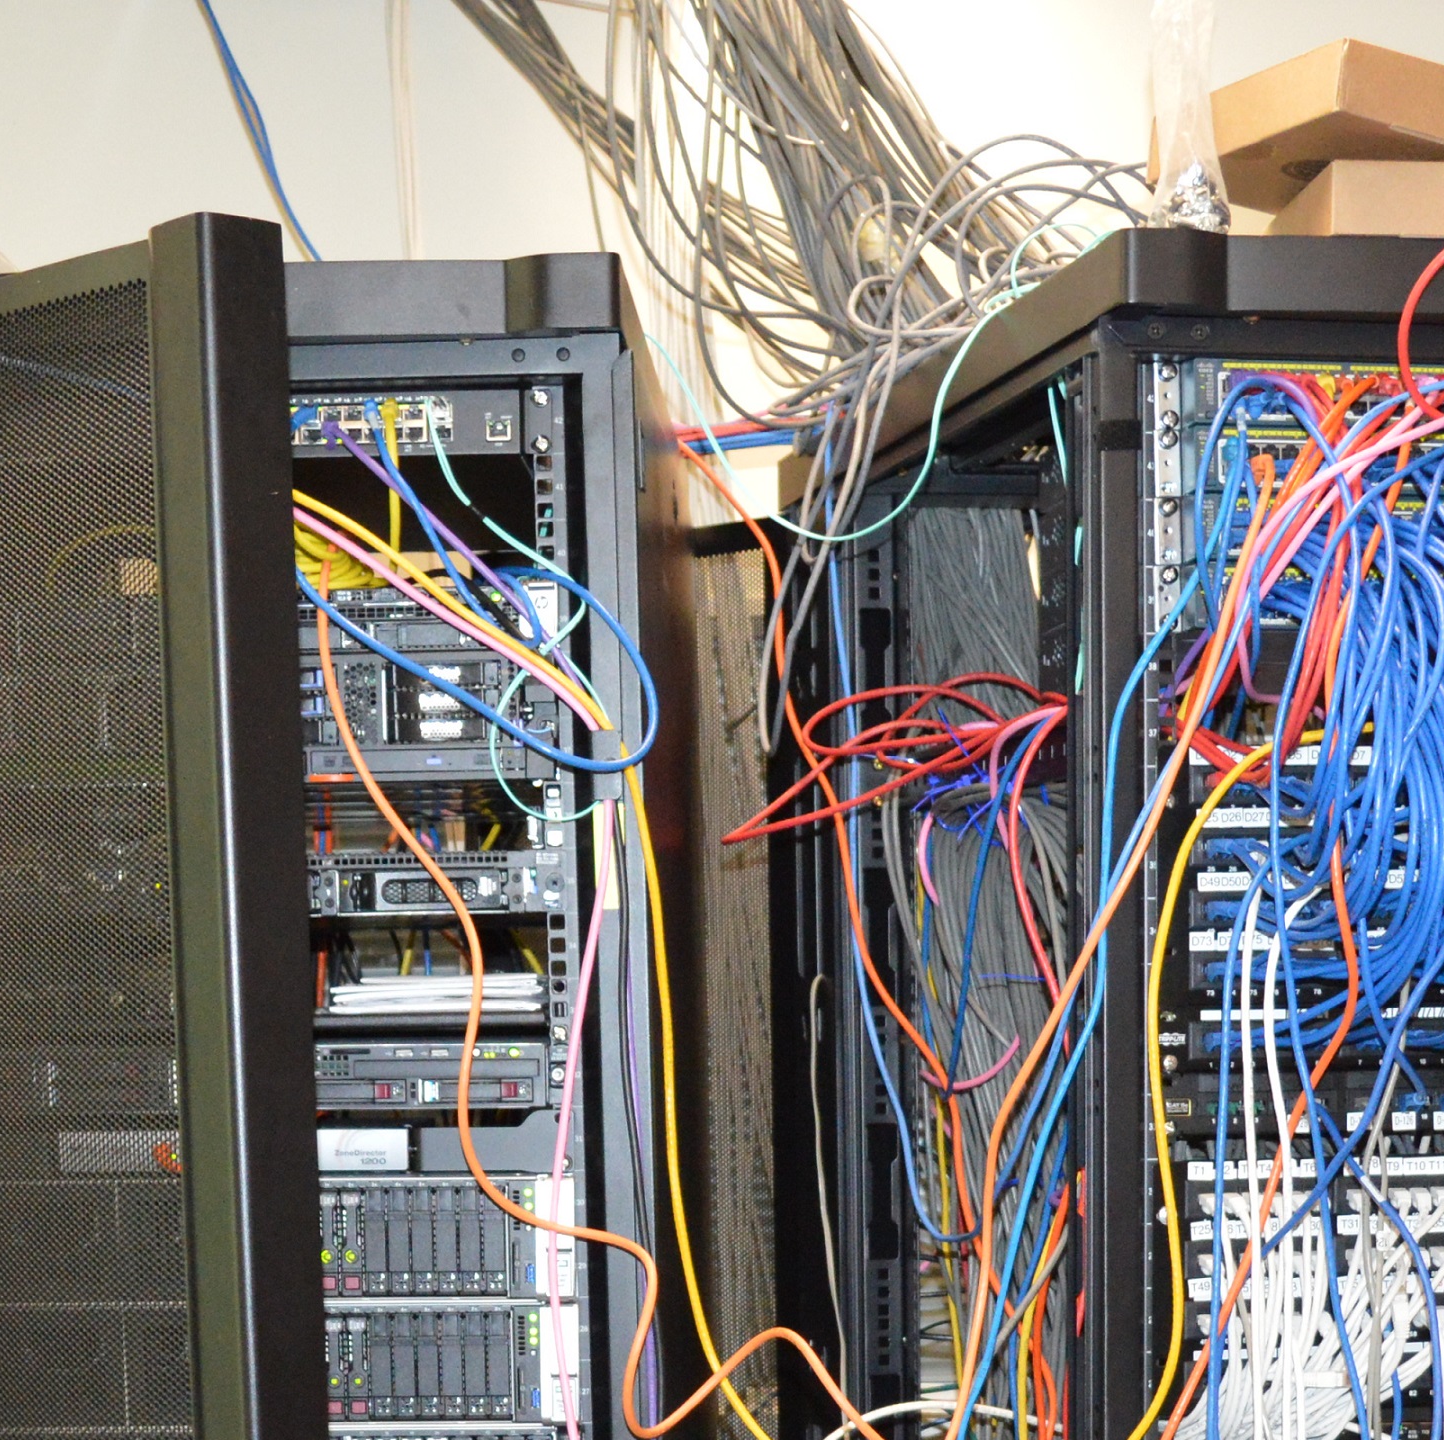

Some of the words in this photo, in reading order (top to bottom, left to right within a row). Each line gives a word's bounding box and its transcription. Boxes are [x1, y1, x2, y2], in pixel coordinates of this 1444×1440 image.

[1221, 812, 1242, 822] D26
[1244, 812, 1265, 822] D27
[1200, 876, 1220, 886] D49
[1221, 876, 1241, 886] D50
[1191, 936, 1212, 946] D73
[1394, 1115, 1415, 1126] D-126
[334, 1149, 387, 1157] ZoneDirector
[360, 1157, 387, 1165] 1200
[1194, 1165, 1205, 1175] T1
[1259, 1163, 1271, 1173] T4
[1304, 1162, 1316, 1172] T6
[1387, 1162, 1399, 1171] T9
[1408, 1161, 1426, 1170] T10
[1193, 1225, 1211, 1235] T25
[1341, 1219, 1359, 1228] T31
[1192, 1281, 1210, 1292] T49
